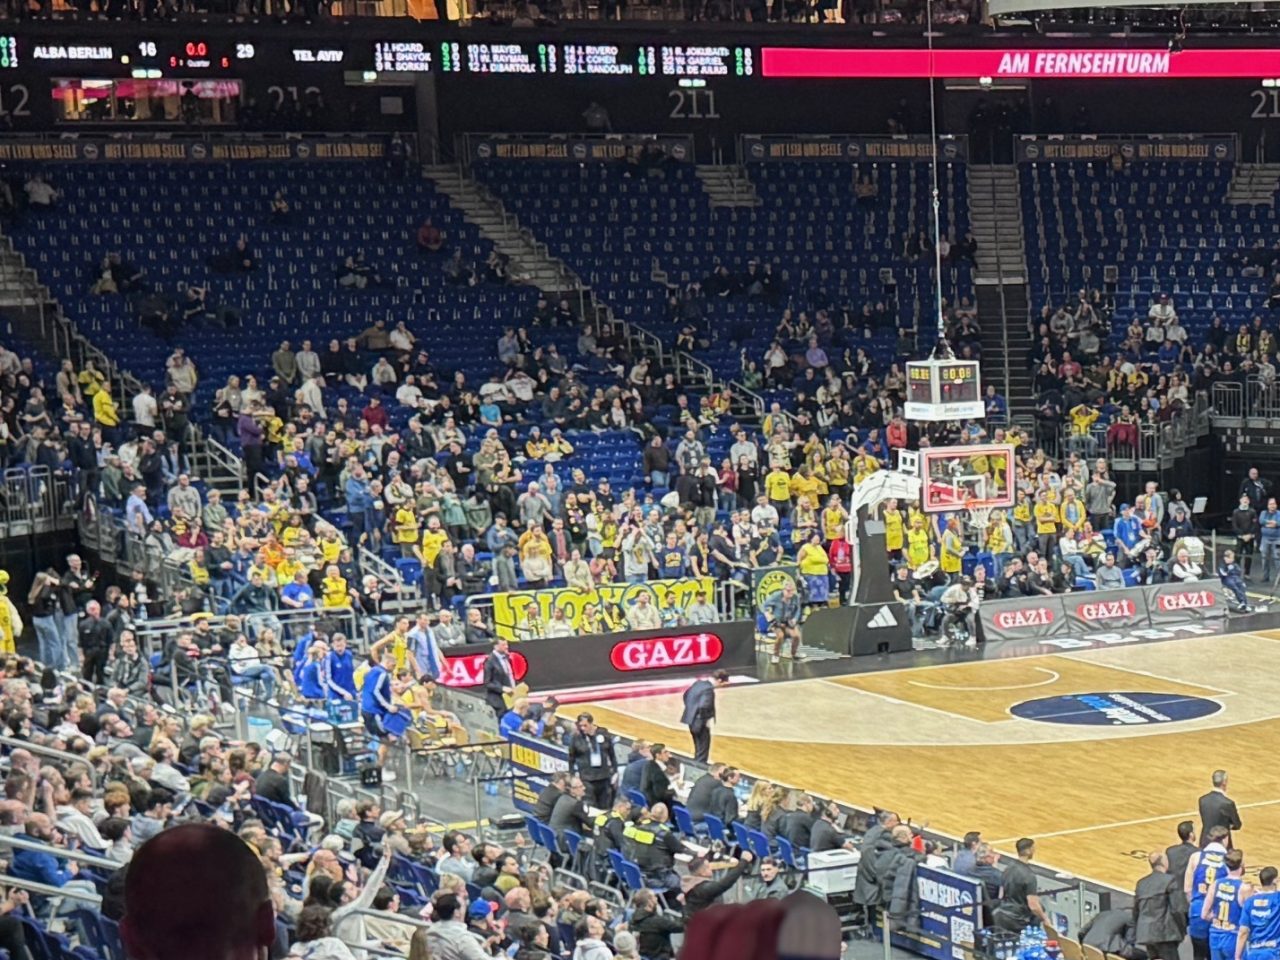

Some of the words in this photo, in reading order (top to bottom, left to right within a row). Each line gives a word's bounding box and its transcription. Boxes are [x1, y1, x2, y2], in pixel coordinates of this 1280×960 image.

[33, 46, 68, 60] ALBA
[68, 46, 113, 60] BERLIN
[185, 42, 207, 56] 0.0
[236, 44, 254, 58] 29
[293, 50, 315, 61] TEL
[317, 50, 343, 61] AVIV
[998, 52, 1029, 74] AM
[1035, 52, 1170, 74] FERNSEHTURM
[669, 90, 720, 119] 211
[1217, 900, 1230, 921] 11
